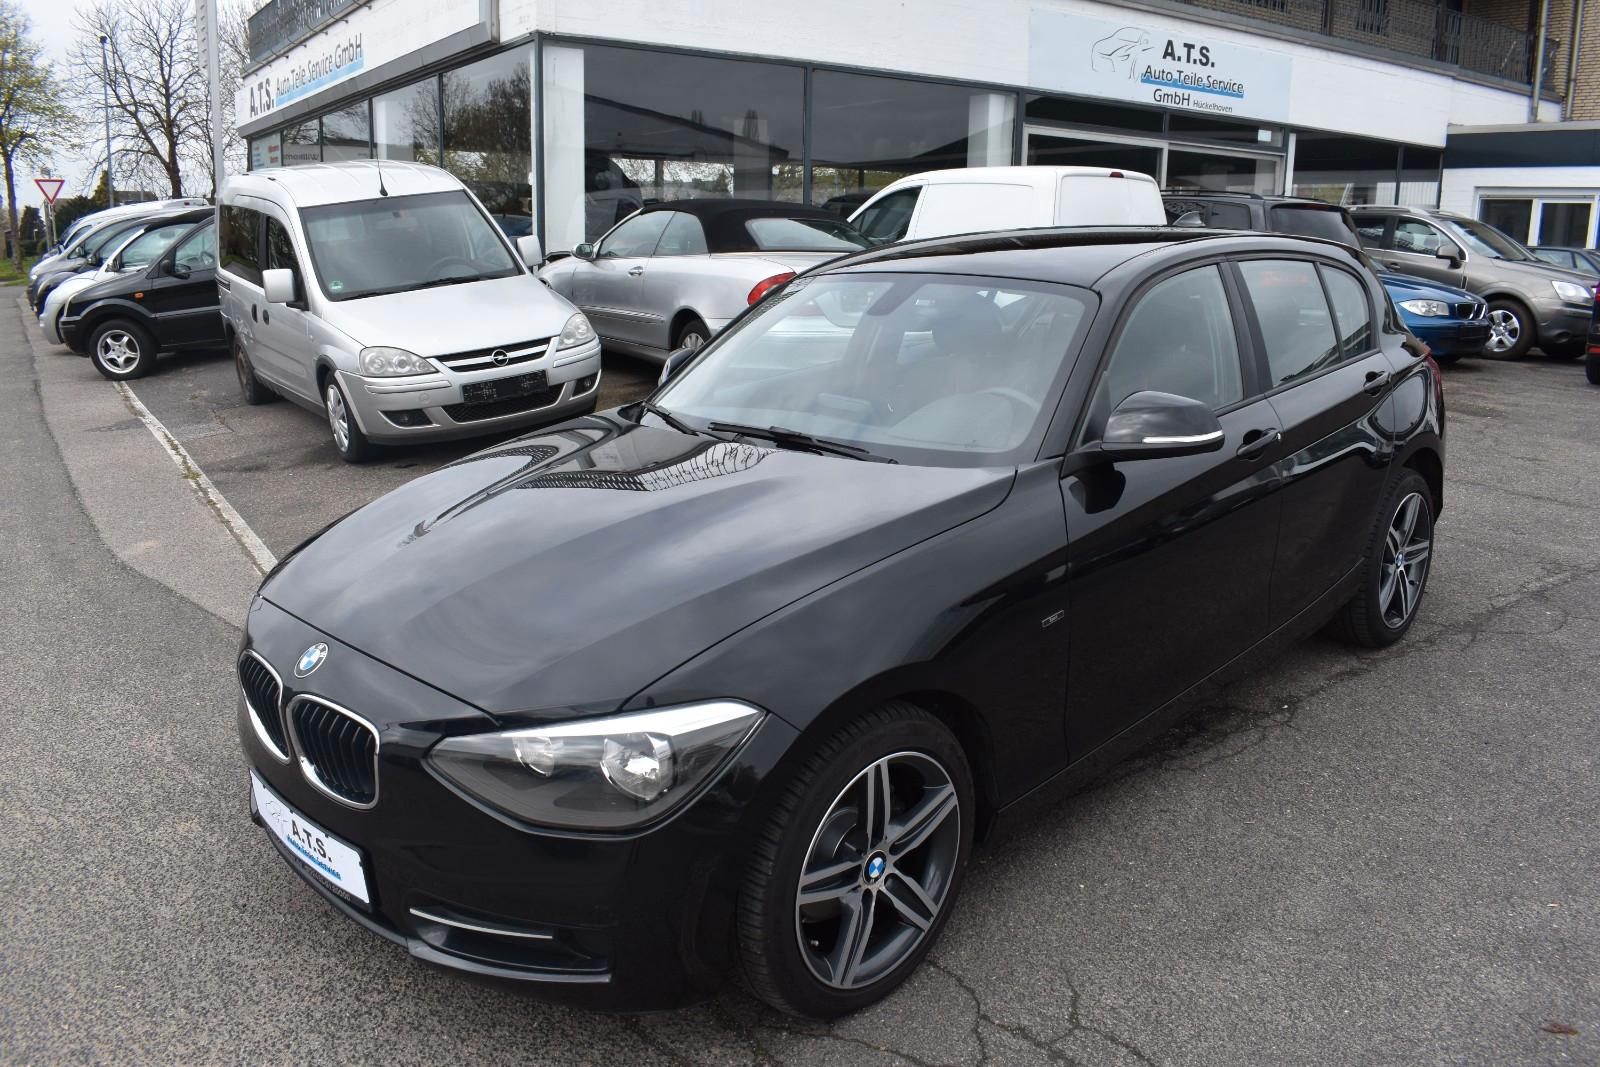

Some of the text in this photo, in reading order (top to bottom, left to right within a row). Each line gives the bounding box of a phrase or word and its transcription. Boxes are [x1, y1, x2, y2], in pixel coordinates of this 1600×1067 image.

[1162, 39, 1215, 68] A.T.S.
[250, 77, 274, 118] A.T.S.
[276, 77, 290, 97] Auto
[307, 52, 333, 83] Service
[334, 32, 362, 69] GmbH
[1143, 64, 1244, 94] Auto Teile Service
[1153, 88, 1191, 107] GmbH
[291, 819, 333, 863] A.T.S.
